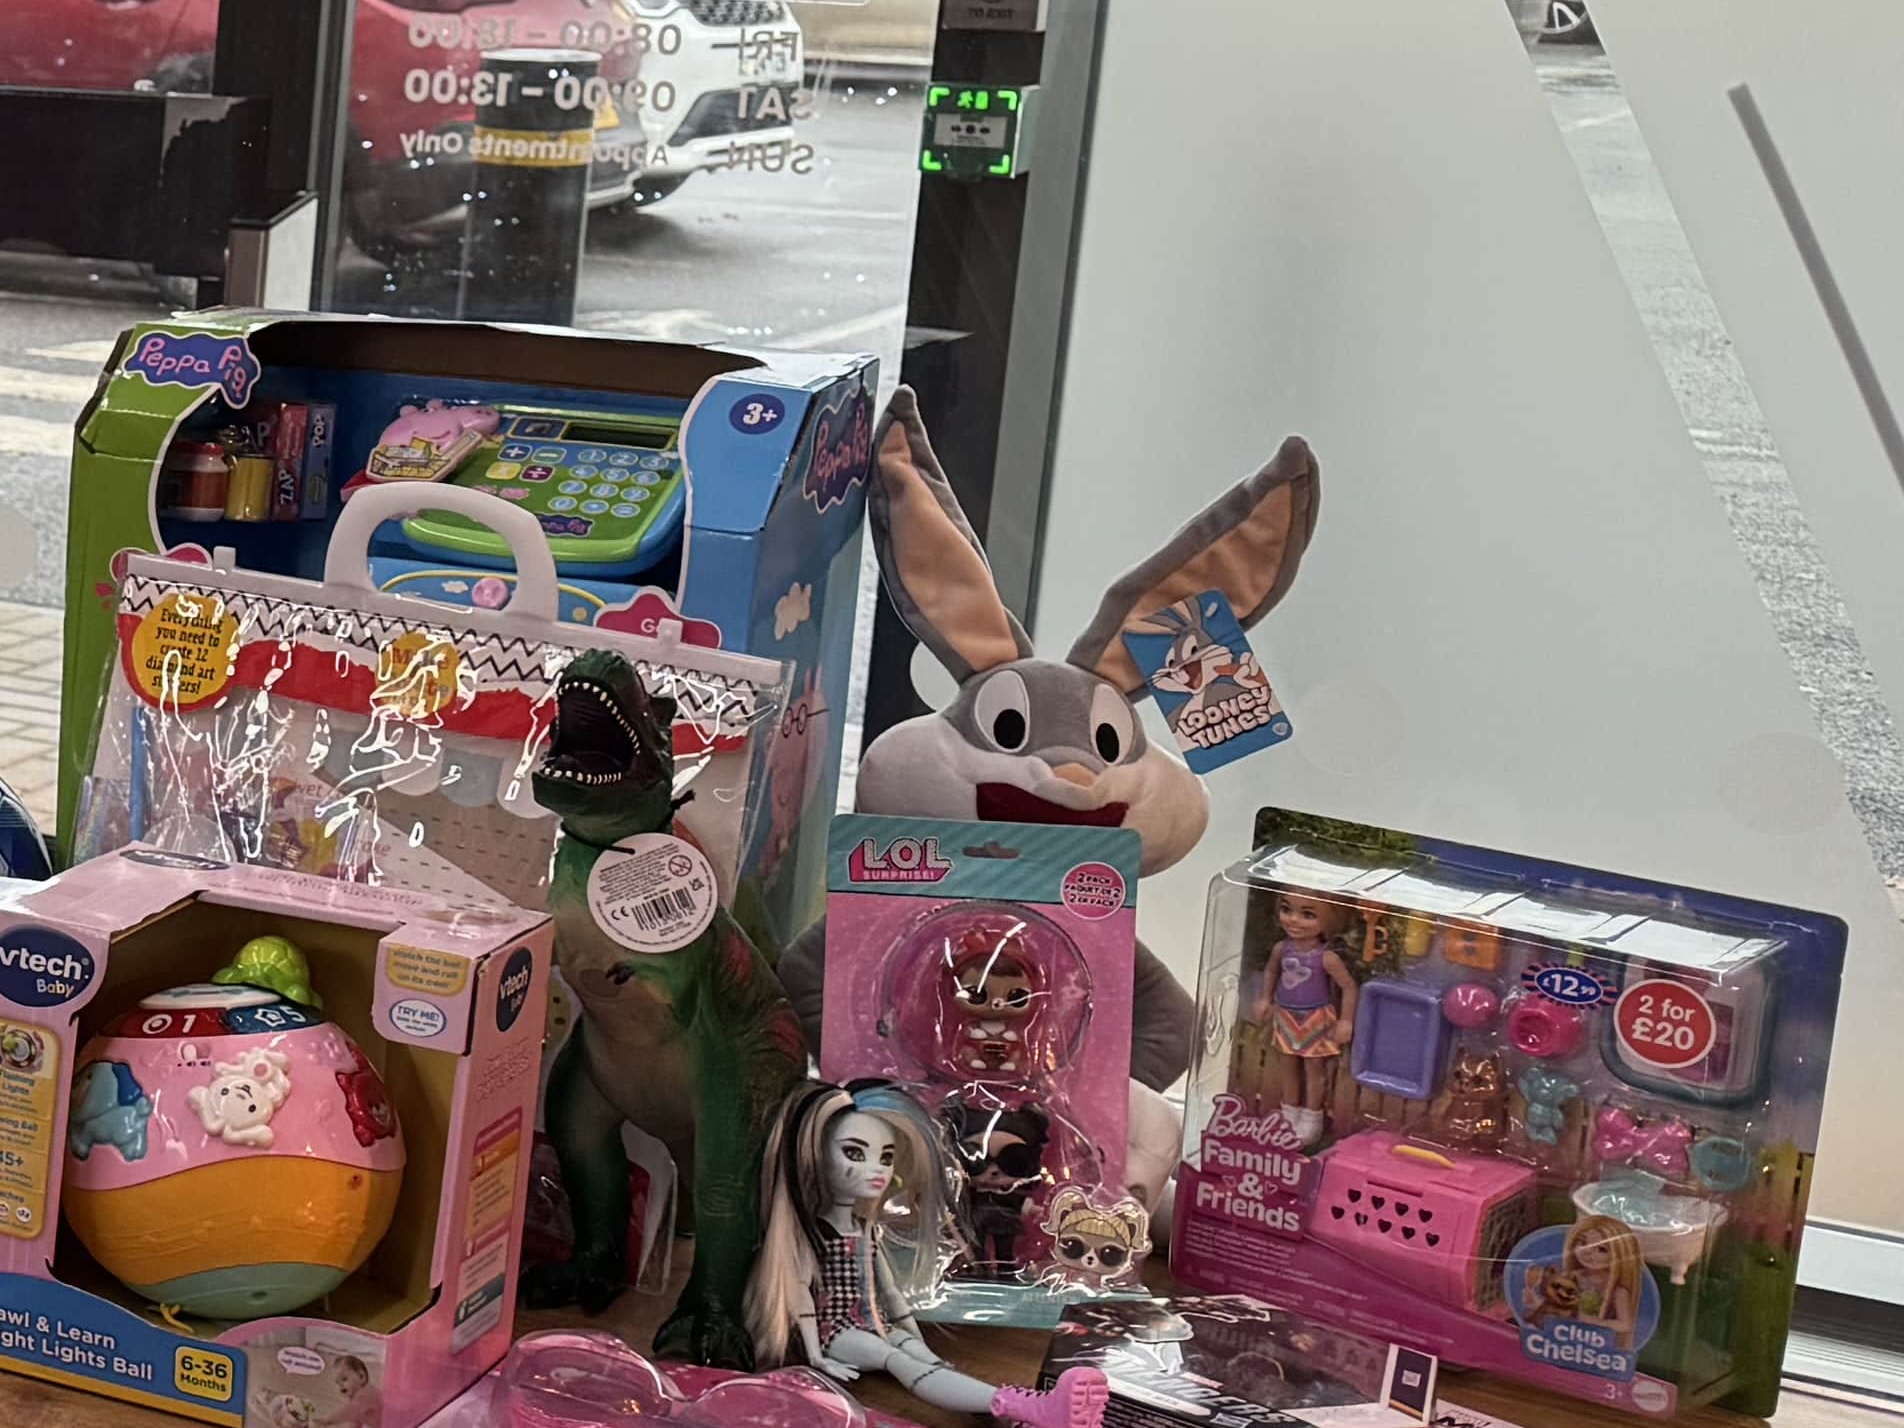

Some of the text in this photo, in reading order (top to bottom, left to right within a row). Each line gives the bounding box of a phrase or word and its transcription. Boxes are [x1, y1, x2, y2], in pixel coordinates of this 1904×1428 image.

[139, 337, 248, 399] Peppa Pig
[311, 413, 325, 448] POP
[743, 401, 778, 426] 3+
[278, 468, 296, 505] ZAP
[155, 625, 206, 645] you need
[1177, 684, 1272, 738] LOONEY
[1192, 703, 1272, 750] TUNES
[863, 836, 953, 870] LOL
[862, 869, 936, 881] SURPRISE!
[35, 978, 75, 999] Baby
[397, 1005, 440, 1023] TRY ME!
[1637, 993, 1696, 1023] 2 for
[1630, 1015, 1696, 1052] £20
[1208, 1095, 1301, 1150] Barbie
[1201, 1140, 1303, 1186] Family
[1238, 1174, 1265, 1198] &
[1195, 1181, 1302, 1233] Friends
[36, 1316, 51, 1334] &
[56, 1321, 117, 1351] Learn
[1552, 1321, 1607, 1350] Club
[41, 1336, 107, 1370] Lights
[112, 1356, 153, 1382] Ball
[180, 1354, 229, 1380] 6-36
[1524, 1333, 1628, 1374] Chelsea
[179, 1374, 228, 1393] Months
